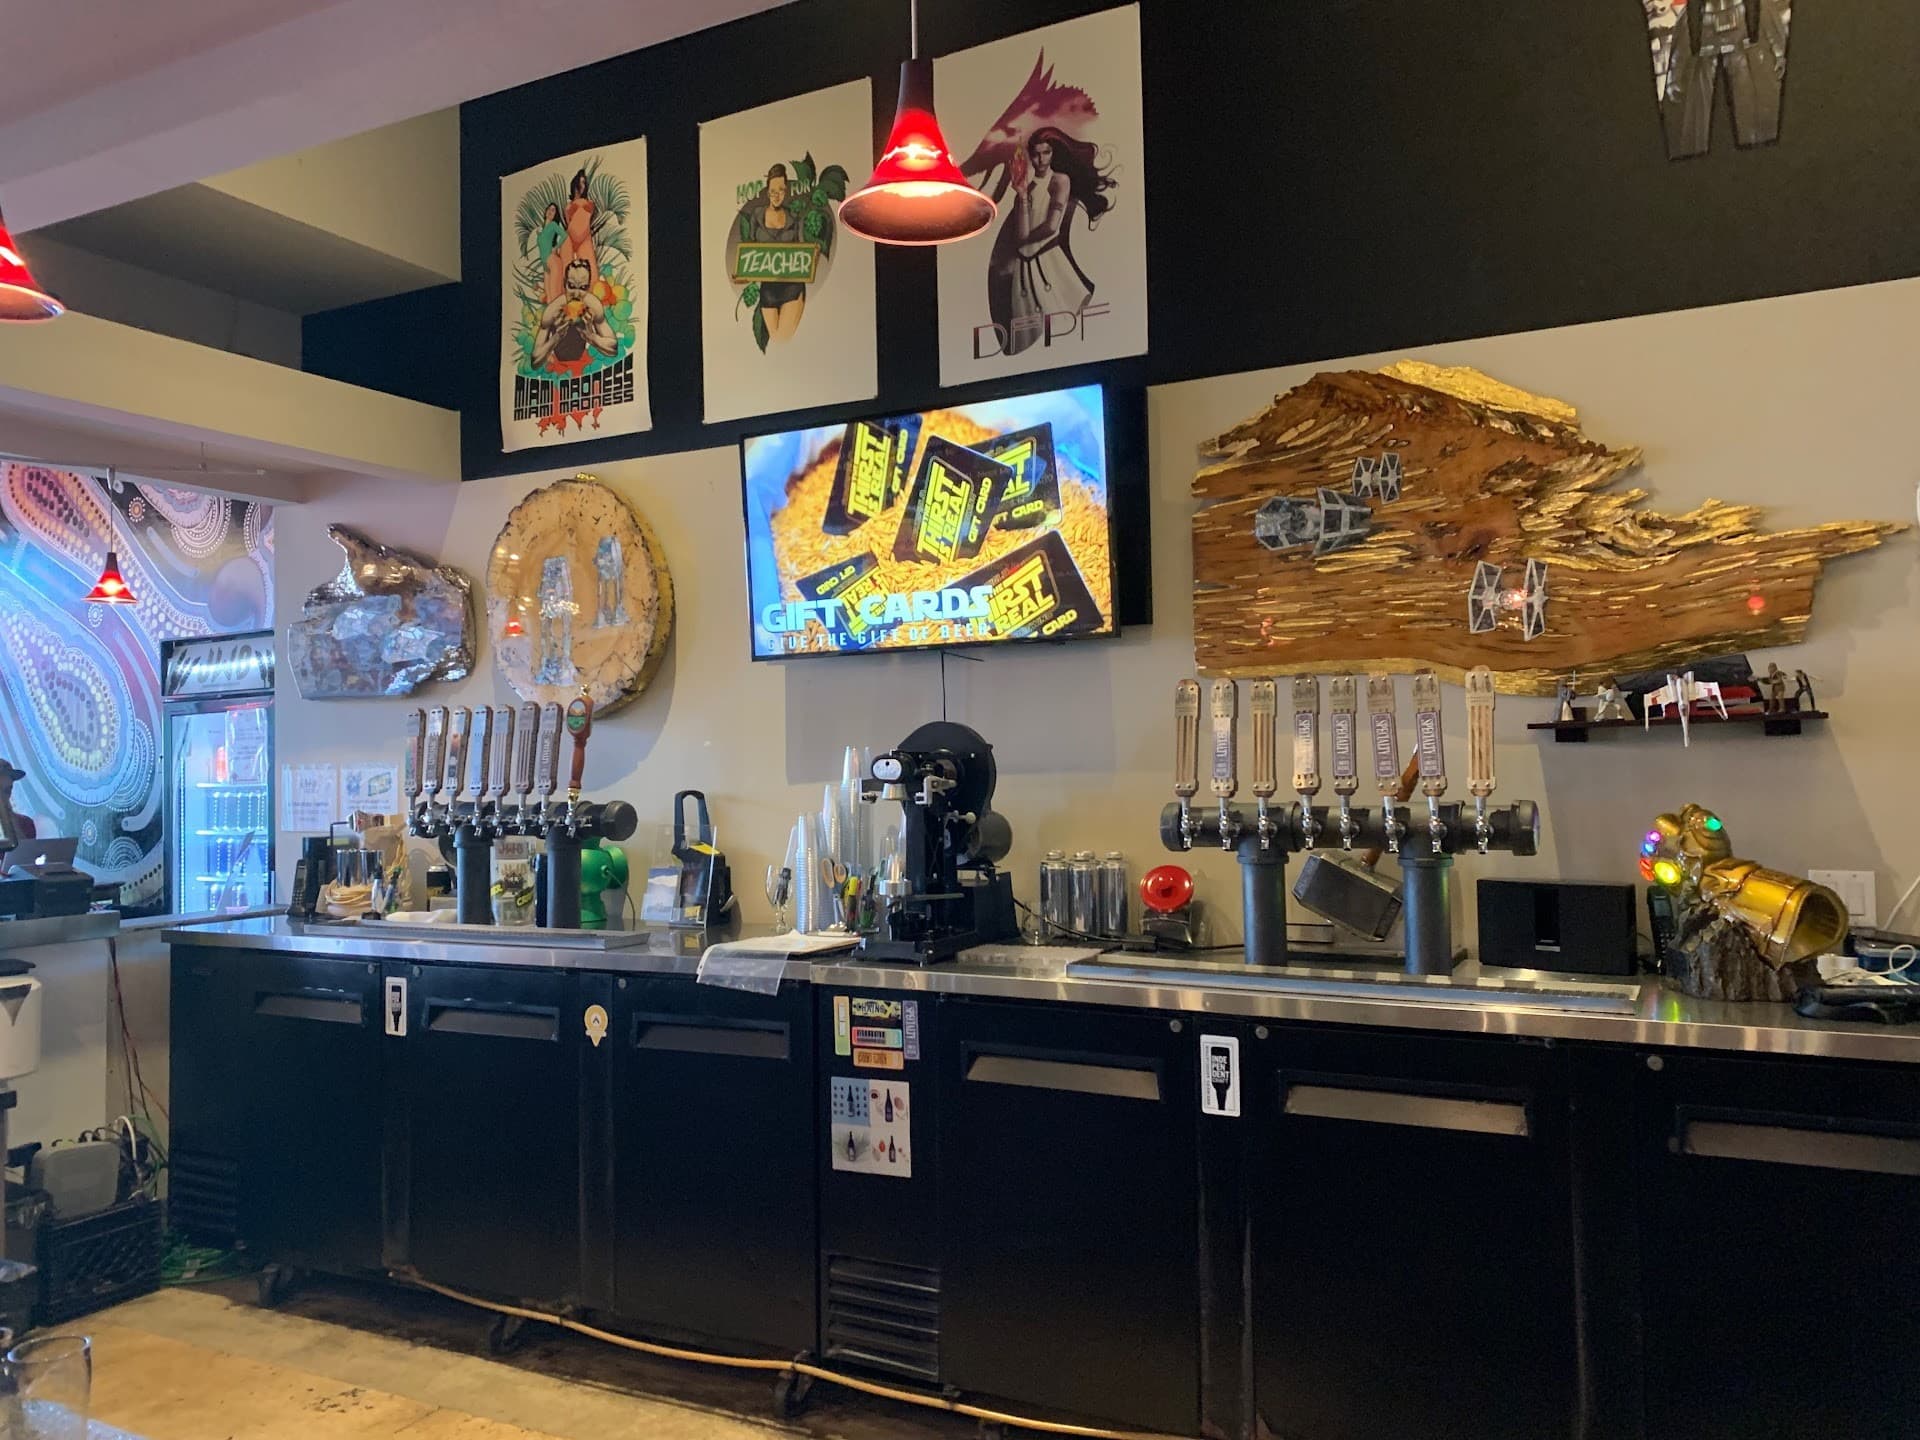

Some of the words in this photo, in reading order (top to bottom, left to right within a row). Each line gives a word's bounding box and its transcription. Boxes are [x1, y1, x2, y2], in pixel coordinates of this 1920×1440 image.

[736, 180, 763, 205] HOP
[790, 179, 811, 197] FOR
[740, 250, 812, 275] TEACHER
[514, 374, 554, 410] MIAMI
[559, 352, 634, 402] MADNESS
[850, 424, 877, 514] THIRST
[869, 435, 887, 495] REAL
[916, 464, 953, 556] THIRST
[943, 480, 967, 542] REAL
[968, 515, 980, 541] GIFT
[975, 477, 991, 512] CARD
[1011, 499, 1043, 517] CARD
[762, 598, 843, 634] GIFT
[860, 584, 993, 626] CARDS
[993, 593, 1052, 634] REAL
[1043, 609, 1075, 635] CARD
[816, 632, 847, 648] THE
[857, 628, 899, 645] GIFT
[908, 626, 930, 641] OF
